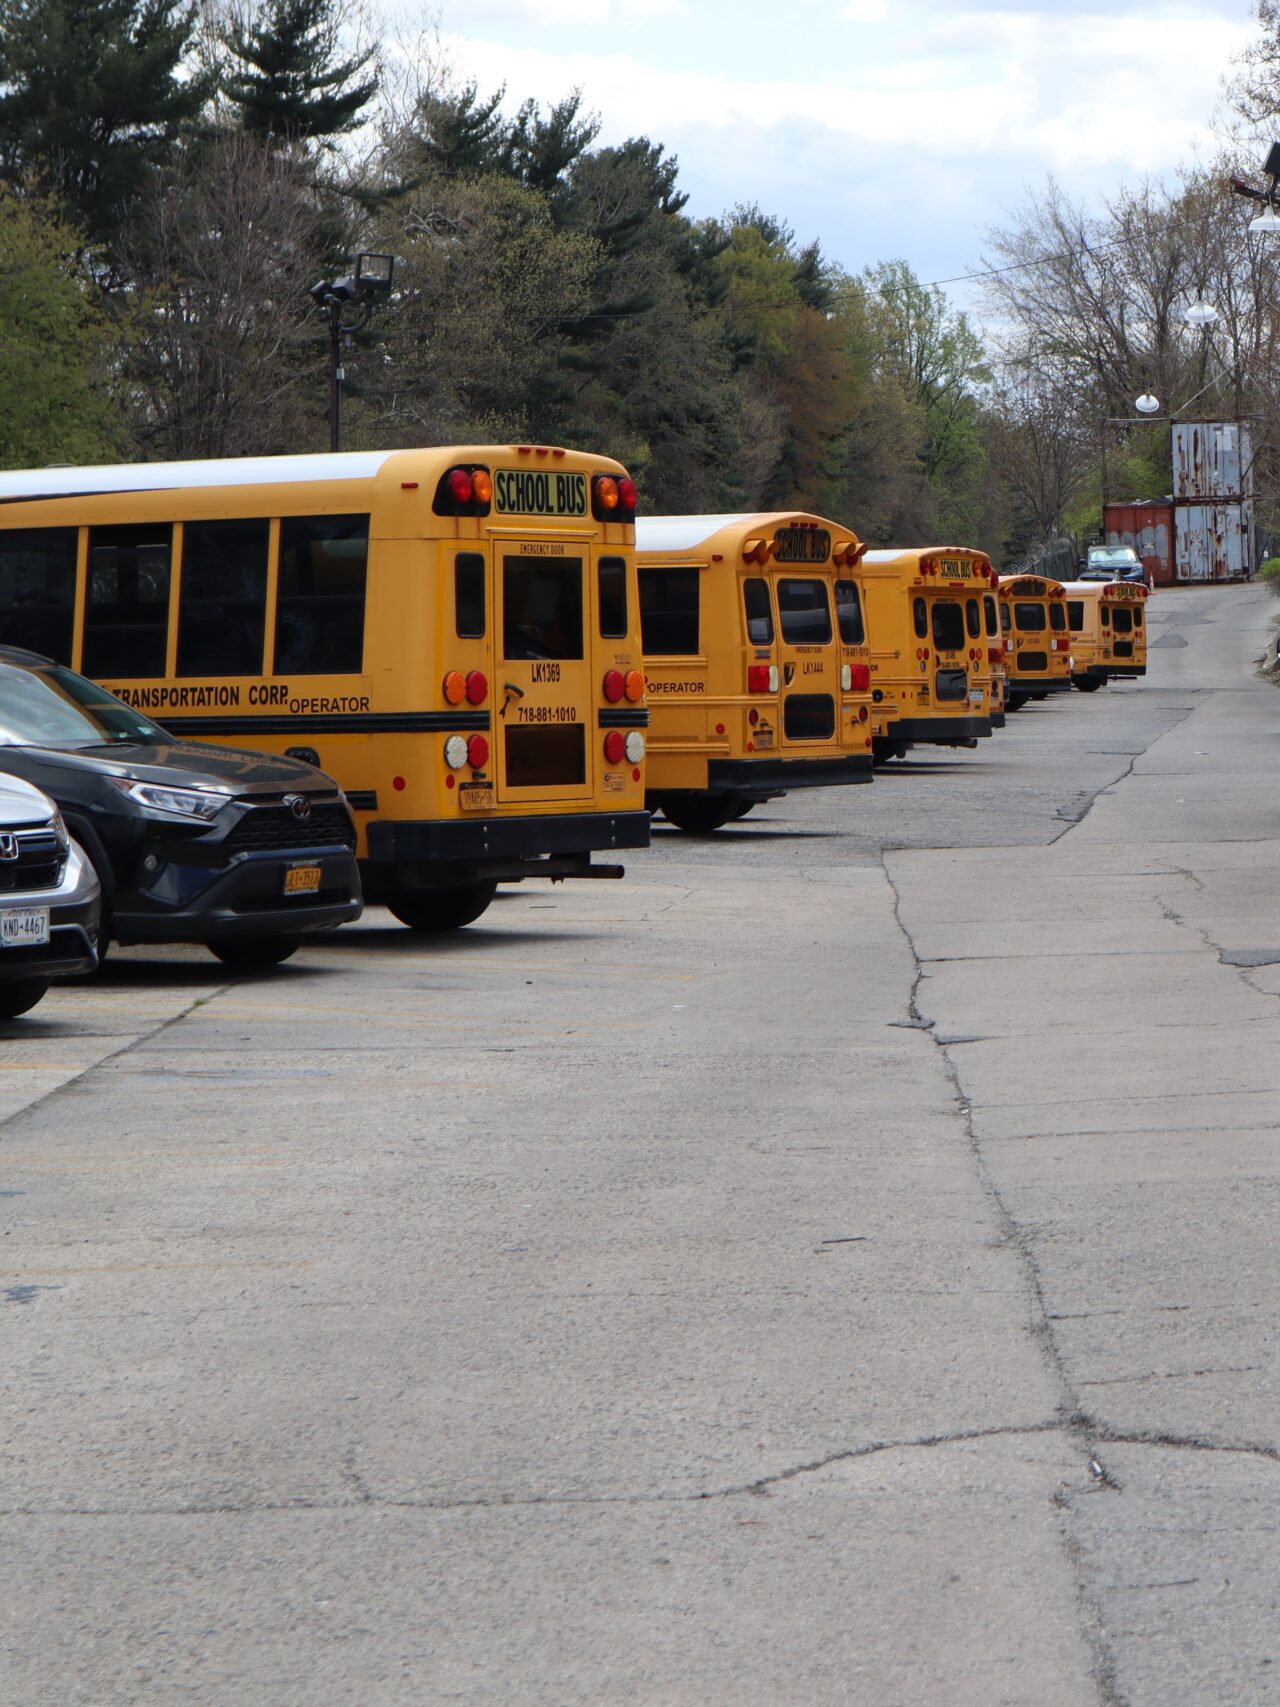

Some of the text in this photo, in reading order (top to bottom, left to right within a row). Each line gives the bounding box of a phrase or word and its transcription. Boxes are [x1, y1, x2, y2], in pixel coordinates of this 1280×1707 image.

[496, 472, 585, 514] SCHOOL BUS
[520, 543, 565, 556] EMERGENCY DOOR
[777, 532, 829, 560] SCHOOL BUS
[940, 560, 971, 579] SCHOOL BUS
[531, 663, 561, 683] LK1369
[803, 661, 824, 676] LK1444
[112, 684, 289, 709] TRANSPORTATION CORP.
[648, 682, 705, 693] OPERATOR
[289, 696, 371, 714] OPERATOR
[517, 706, 577, 723] 718-881-1010
